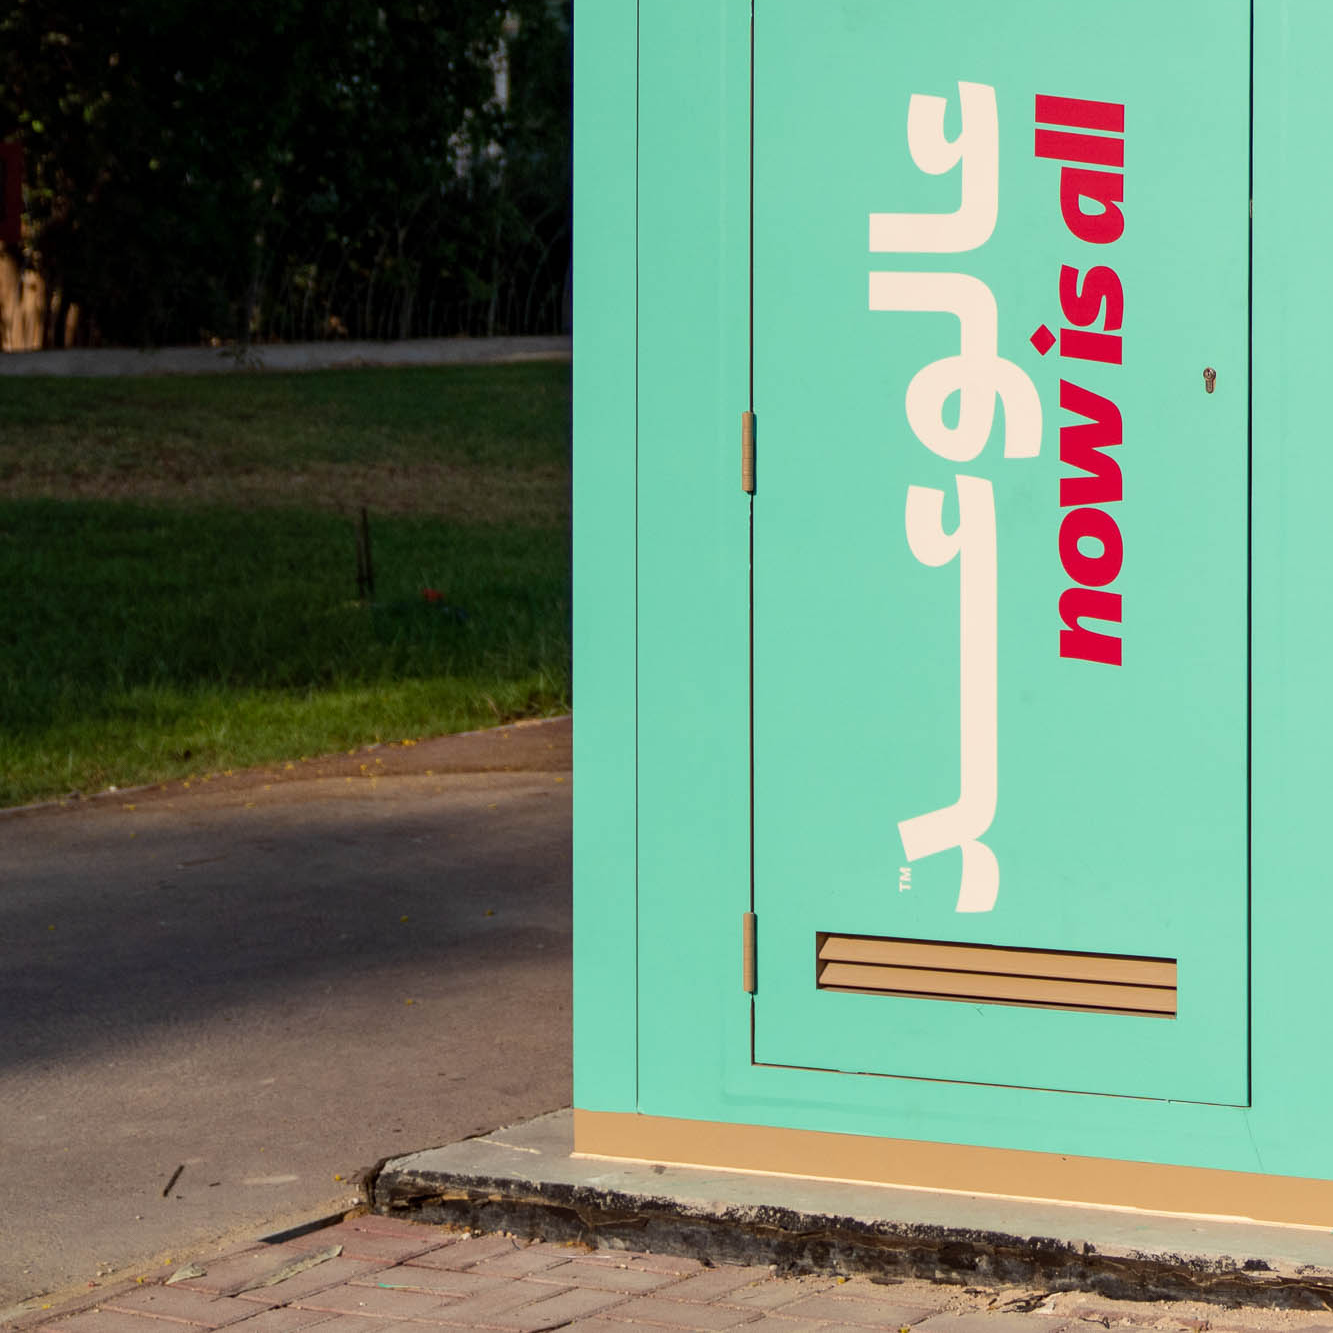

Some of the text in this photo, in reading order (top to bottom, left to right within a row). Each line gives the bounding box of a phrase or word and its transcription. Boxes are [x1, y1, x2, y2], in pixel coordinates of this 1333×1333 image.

[1029, 94, 1125, 667] now is all
